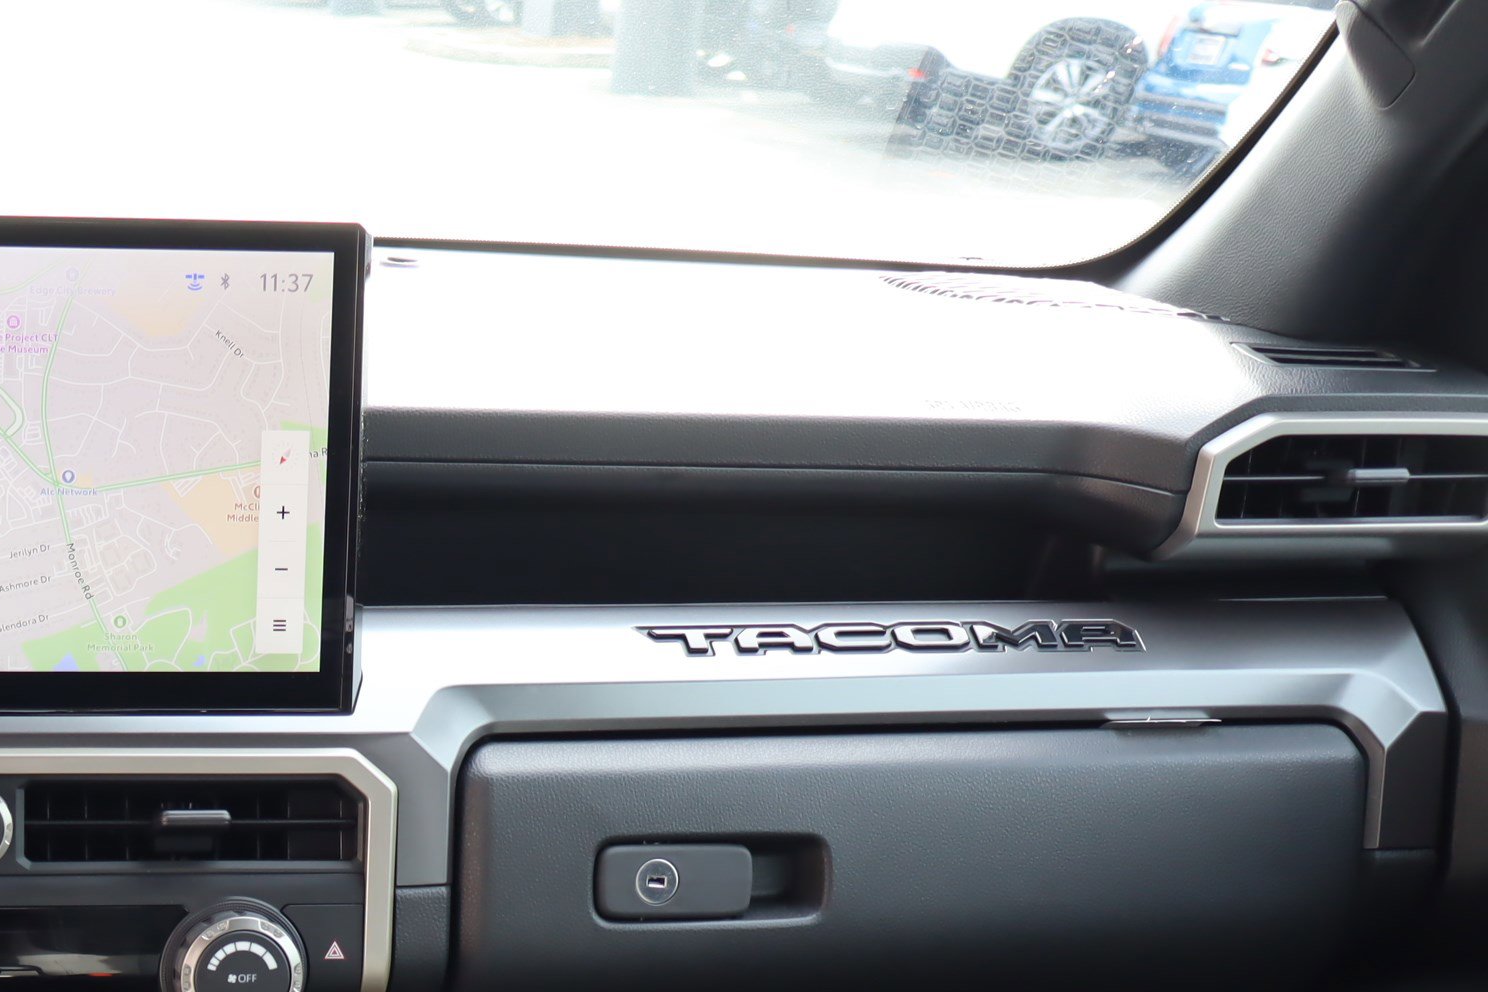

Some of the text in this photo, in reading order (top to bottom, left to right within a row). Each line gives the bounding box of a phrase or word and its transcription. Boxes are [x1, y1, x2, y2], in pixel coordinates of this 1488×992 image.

[259, 272, 314, 293] 11:37
[5, 333, 39, 345] Project
[214, 329, 245, 359] Knell Dr
[8, 344, 49, 354] Museum
[57, 488, 97, 496] Network
[9, 544, 50, 560] Jerilyn Dr
[67, 542, 94, 600] Monroe Rd
[37, 575, 50, 586] Dr
[36, 614, 50, 625] Dr
[103, 633, 137, 642] Sharon
[636, 620, 1146, 656] TACOMA
[87, 643, 154, 653] Memorial Park
[238, 973, 257, 983] OFF
